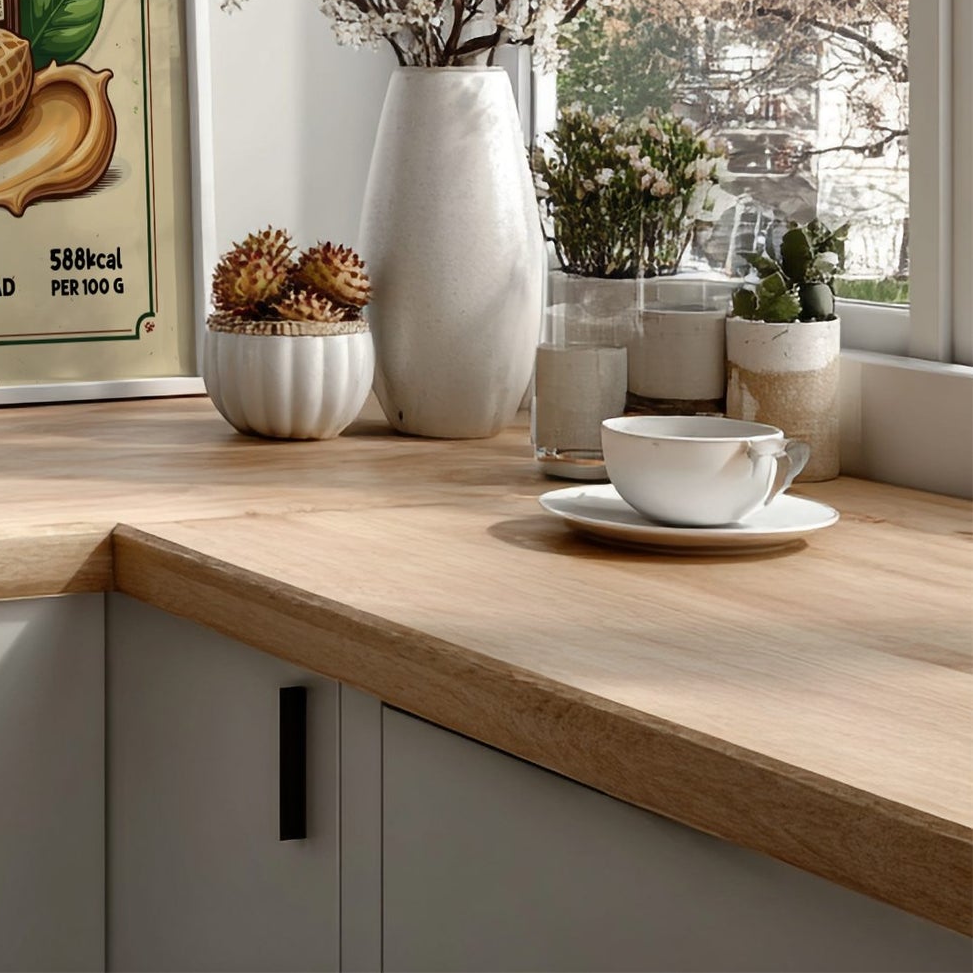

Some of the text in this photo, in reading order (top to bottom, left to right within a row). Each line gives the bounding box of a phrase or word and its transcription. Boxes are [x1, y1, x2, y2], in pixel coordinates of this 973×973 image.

[50, 246, 123, 271] 588kcal
[51, 277, 124, 296] PER 100 G
